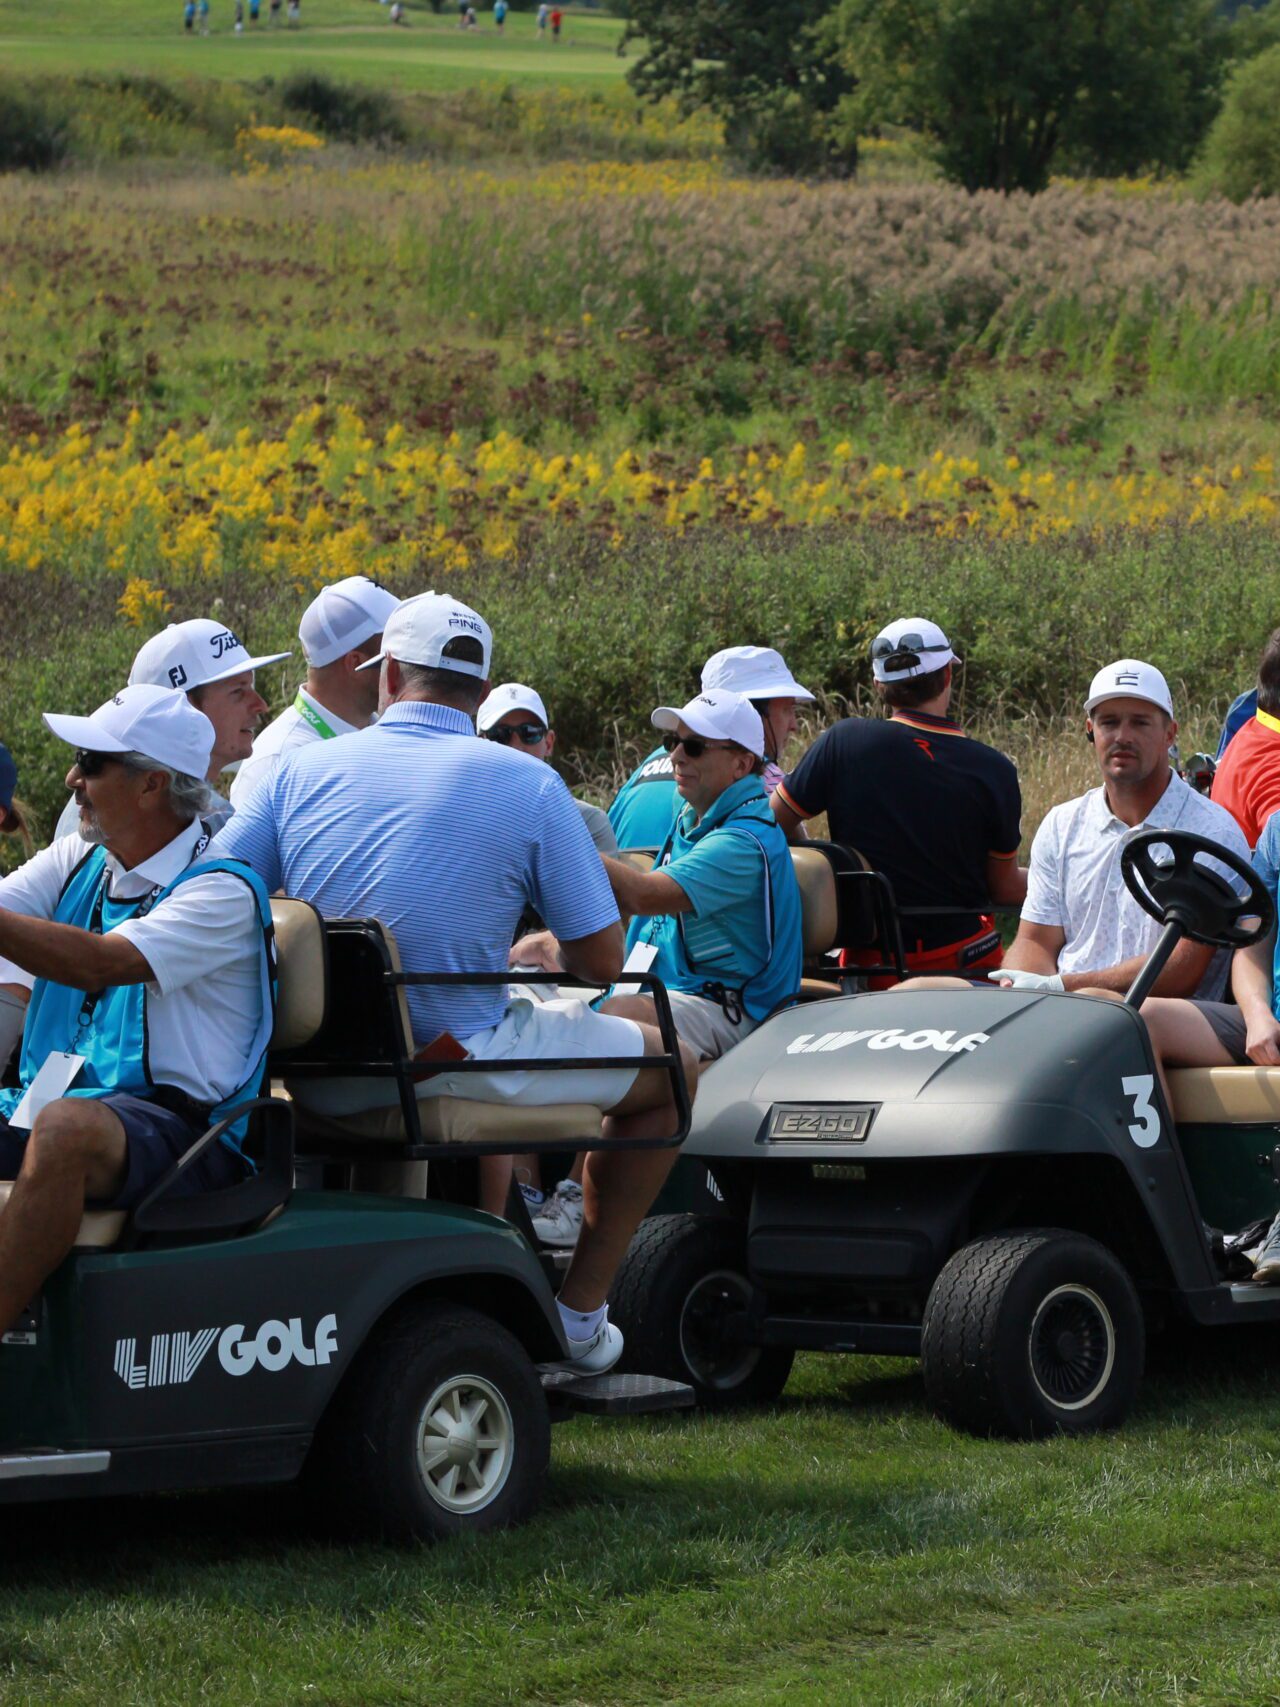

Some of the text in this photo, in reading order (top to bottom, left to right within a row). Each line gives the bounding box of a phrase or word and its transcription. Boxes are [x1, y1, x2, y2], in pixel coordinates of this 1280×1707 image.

[448, 618, 483, 634] PING
[167, 664, 188, 688] FJ
[1121, 1074, 1161, 1148] 3
